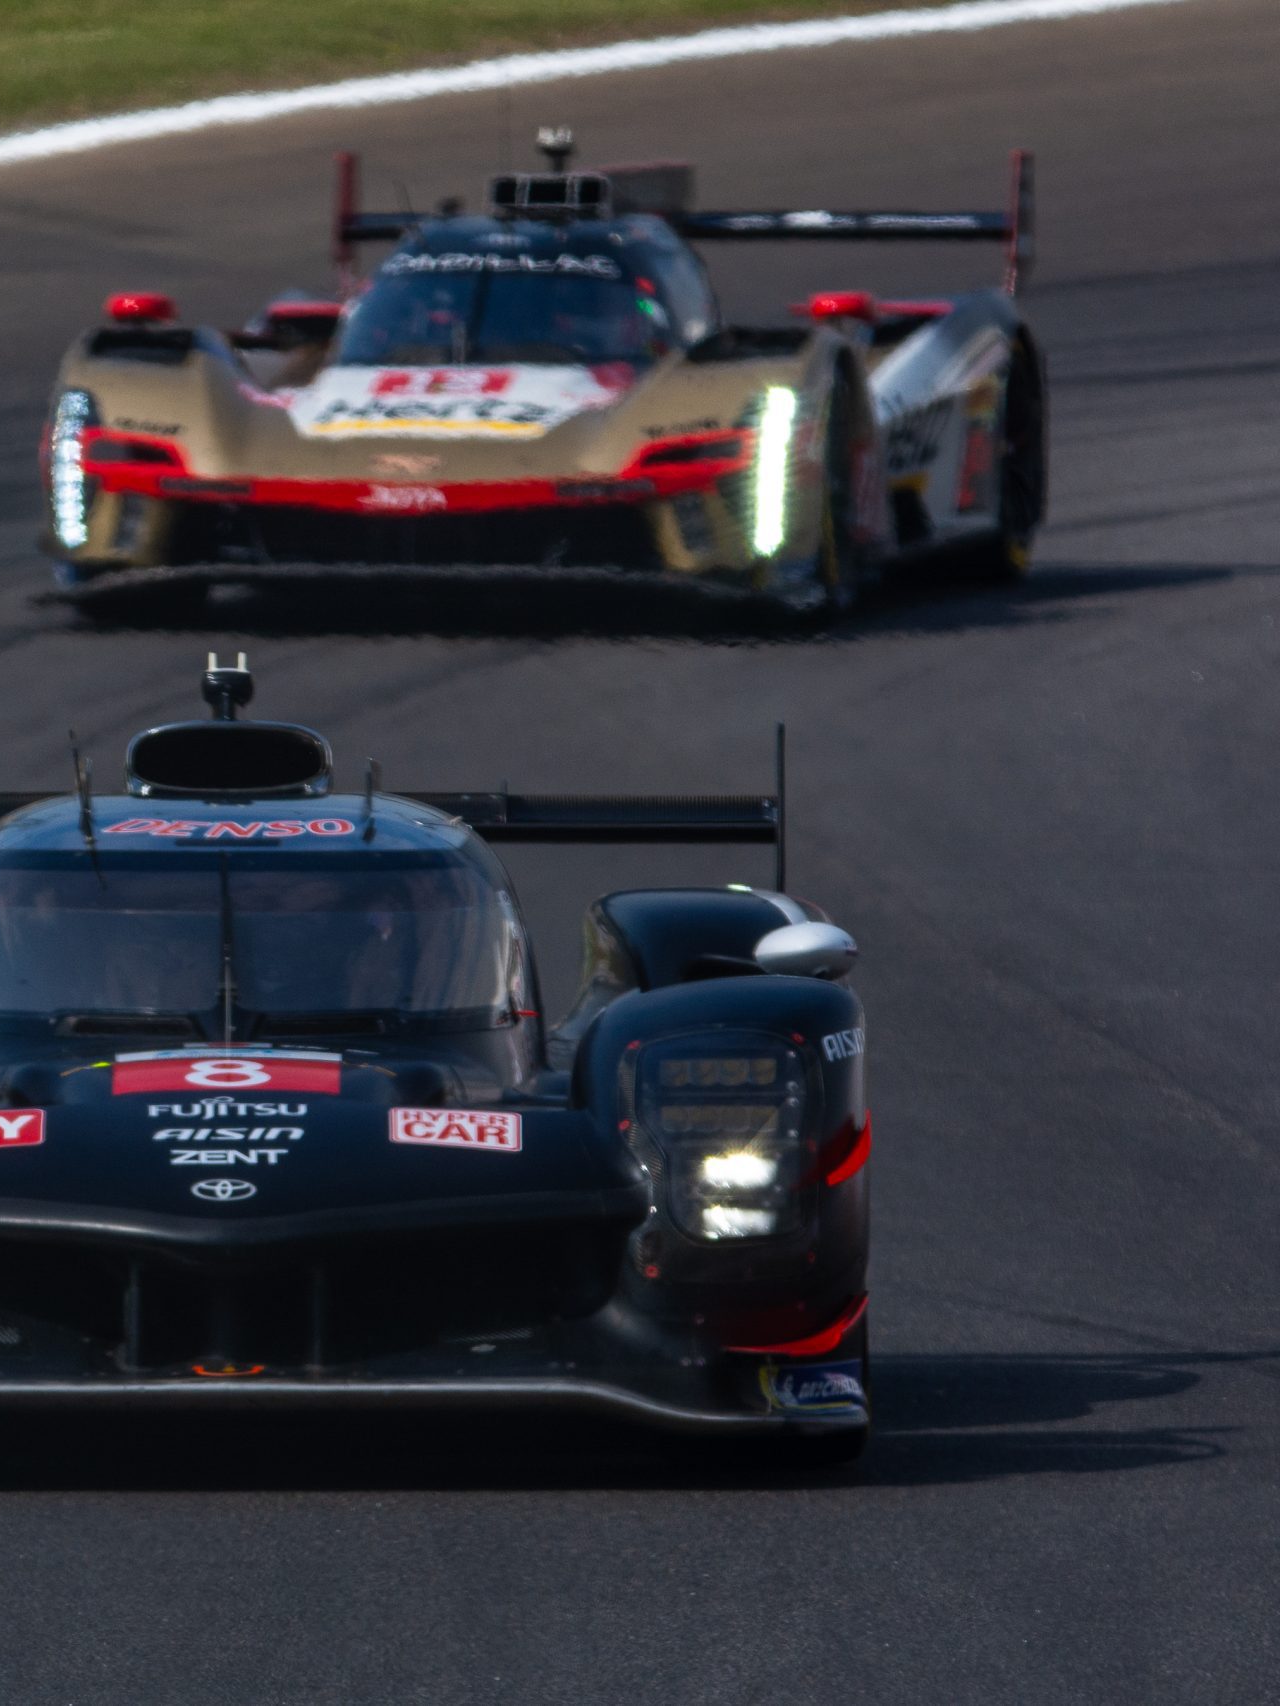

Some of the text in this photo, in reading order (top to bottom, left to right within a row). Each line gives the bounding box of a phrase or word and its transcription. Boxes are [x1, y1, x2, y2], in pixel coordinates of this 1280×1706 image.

[102, 818, 355, 838] DENSO
[185, 1059, 271, 1087] 8
[148, 1096, 308, 1119] FUJITSU
[403, 1110, 508, 1125] HYPER
[152, 1127, 305, 1140] AISIN
[403, 1121, 509, 1145] CAR
[170, 1149, 289, 1165] ZENT
